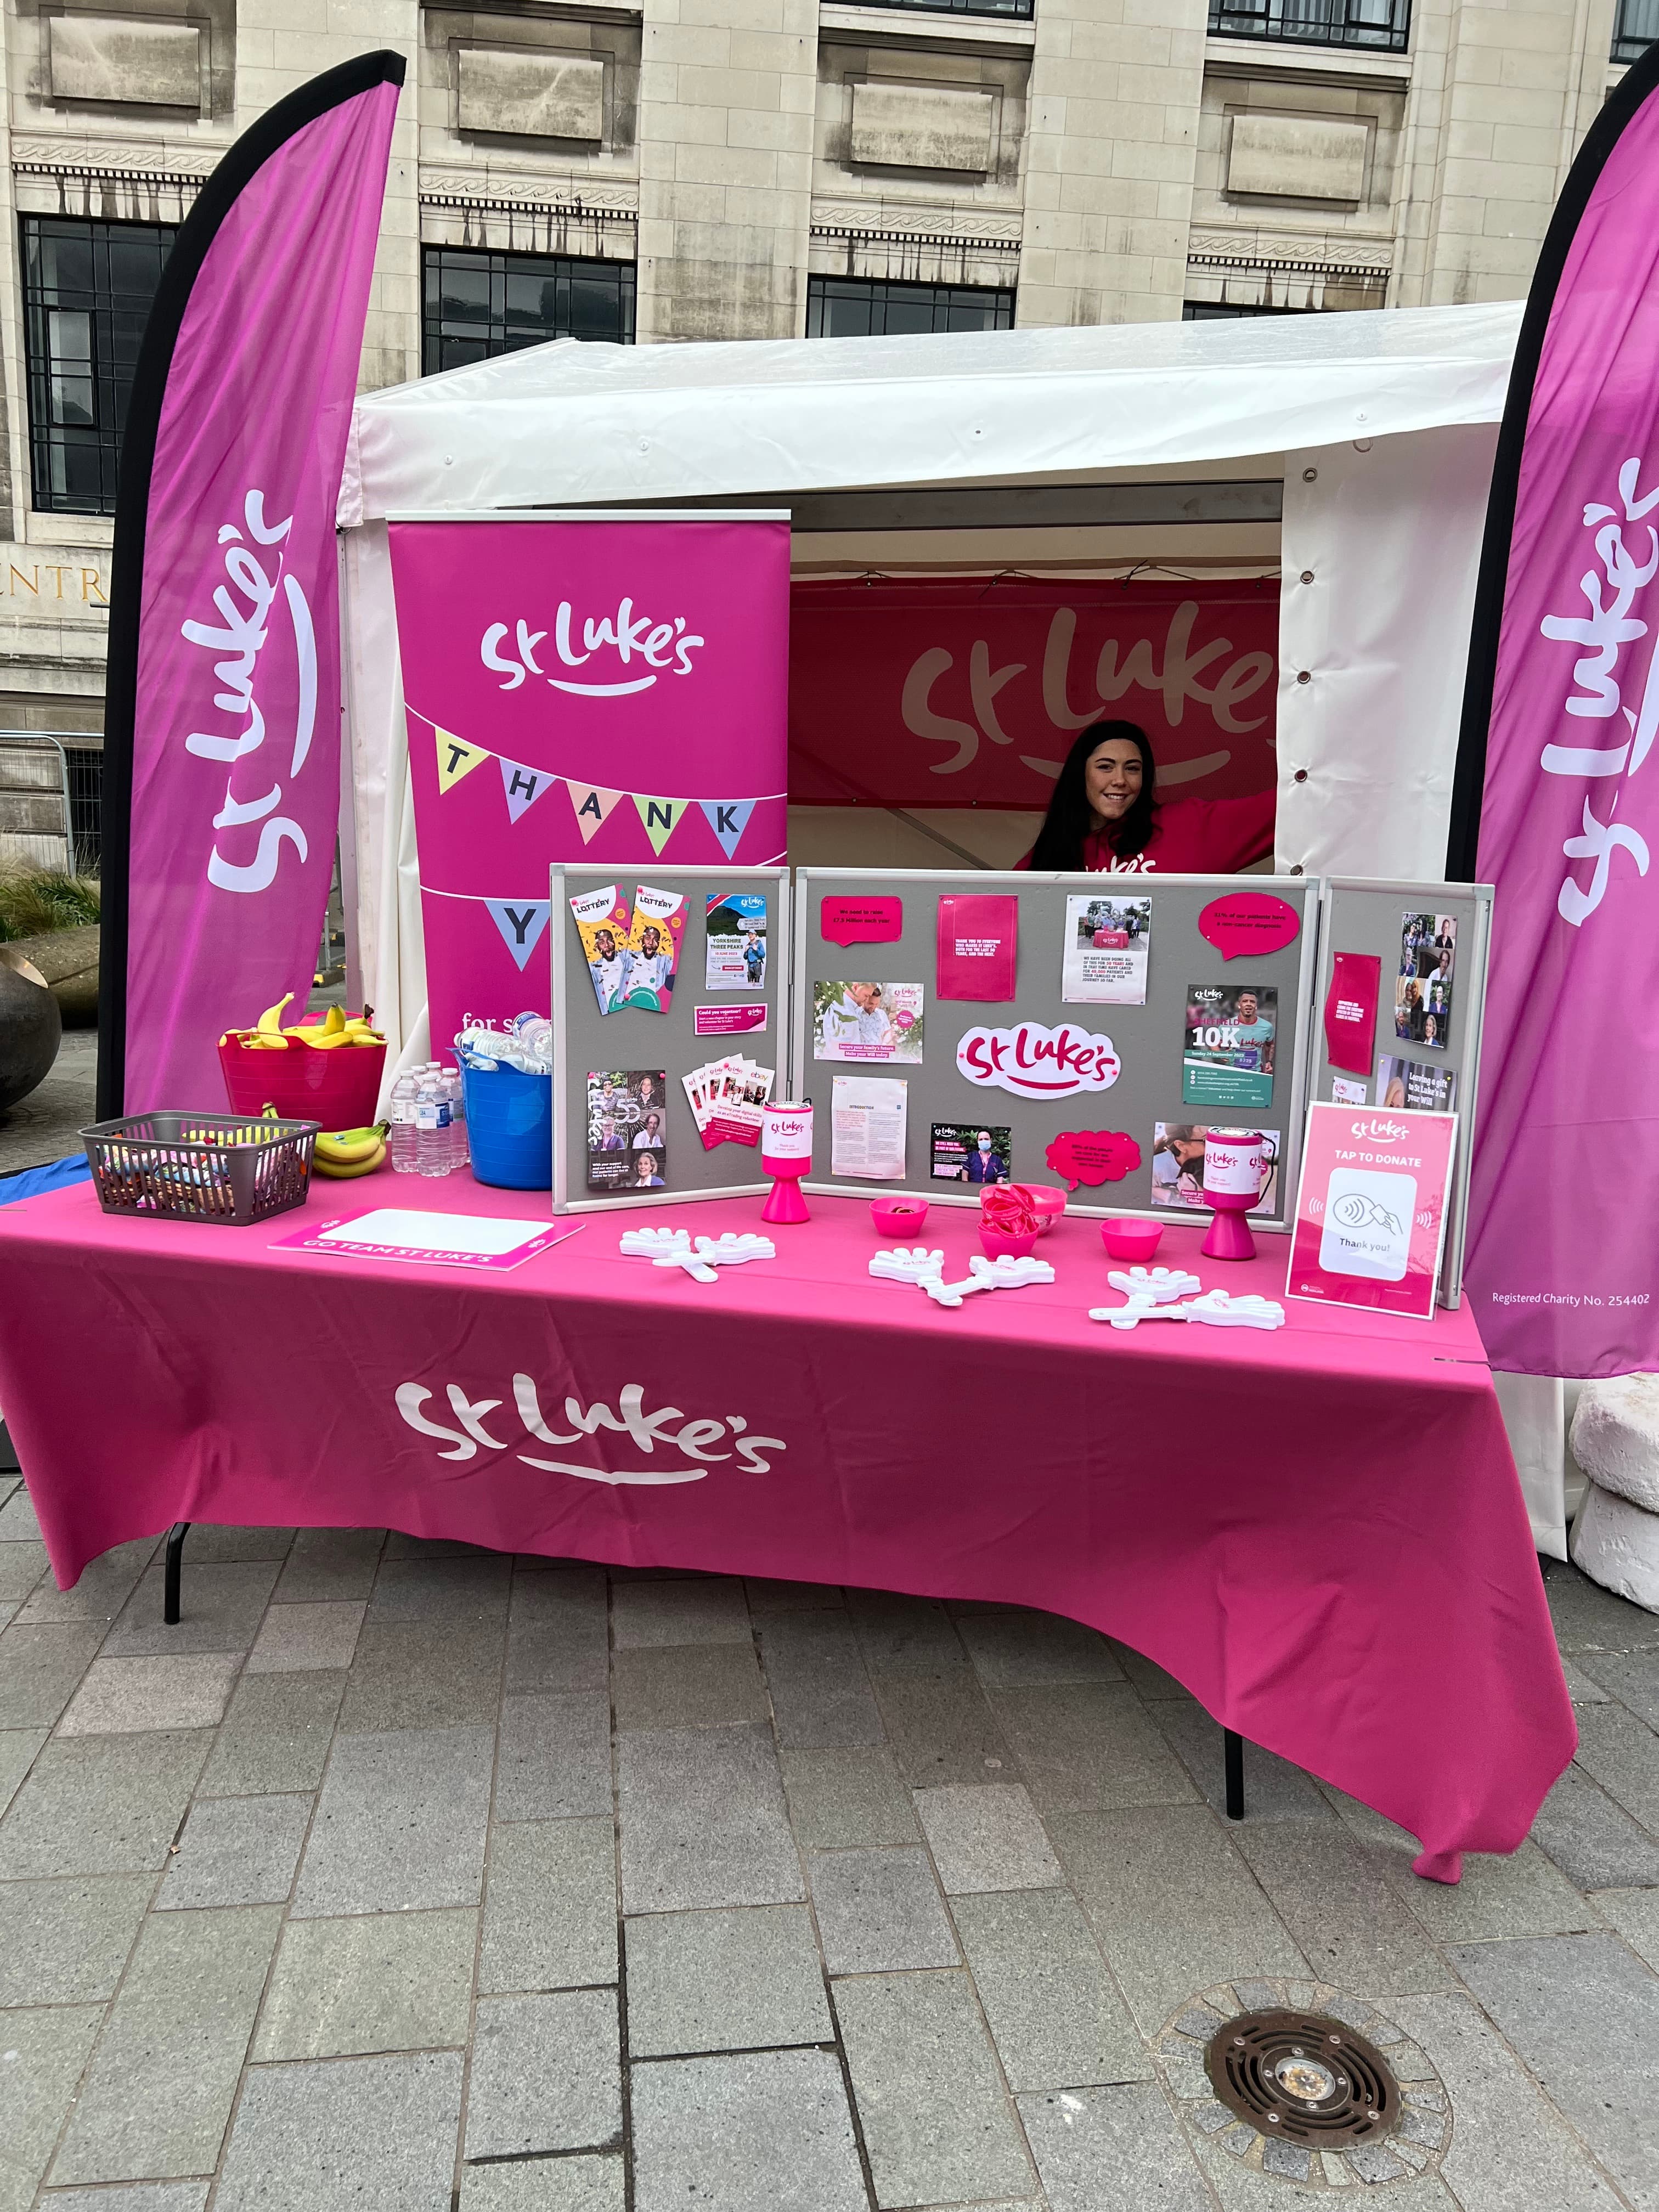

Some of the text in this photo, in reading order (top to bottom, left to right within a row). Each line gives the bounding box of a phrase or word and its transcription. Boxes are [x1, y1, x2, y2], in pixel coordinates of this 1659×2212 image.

[0, 562, 108, 602] NTR
[481, 597, 704, 690] St Luke's
[901, 600, 1276, 774] St Luke
[576, 899, 610, 913] LOTTERY
[640, 896, 673, 909] LOTTERY
[1195, 989, 1224, 1000] St Luke's
[462, 1012, 496, 1032] for
[1192, 1026, 1240, 1047] 10K
[966, 1028, 1115, 1081] St Luke's
[751, 1071, 768, 1081] ebay
[1409, 1072, 1431, 1085] Leaving
[1436, 1079, 1448, 1088] gift
[1414, 1084, 1420, 1092] St
[1420, 1085, 1439, 1096] Luke's
[1440, 1090, 1446, 1098] in
[1408, 1094, 1433, 1105] your Will
[771, 1123, 781, 1134] St
[782, 1121, 804, 1132] Luke's
[1351, 1119, 1410, 1140] St Luke's
[1213, 1152, 1238, 1166] Luke's
[1335, 1149, 1422, 1168] TAP TO DONATE
[1340, 1237, 1391, 1252] Thank you!
[340, 1243, 396, 1254] TEAM
[422, 1251, 494, 1263] LUKE'S
[1492, 1292, 1650, 1307] Registered Charity No. 254402
[394, 1373, 787, 1474] St Luke's
